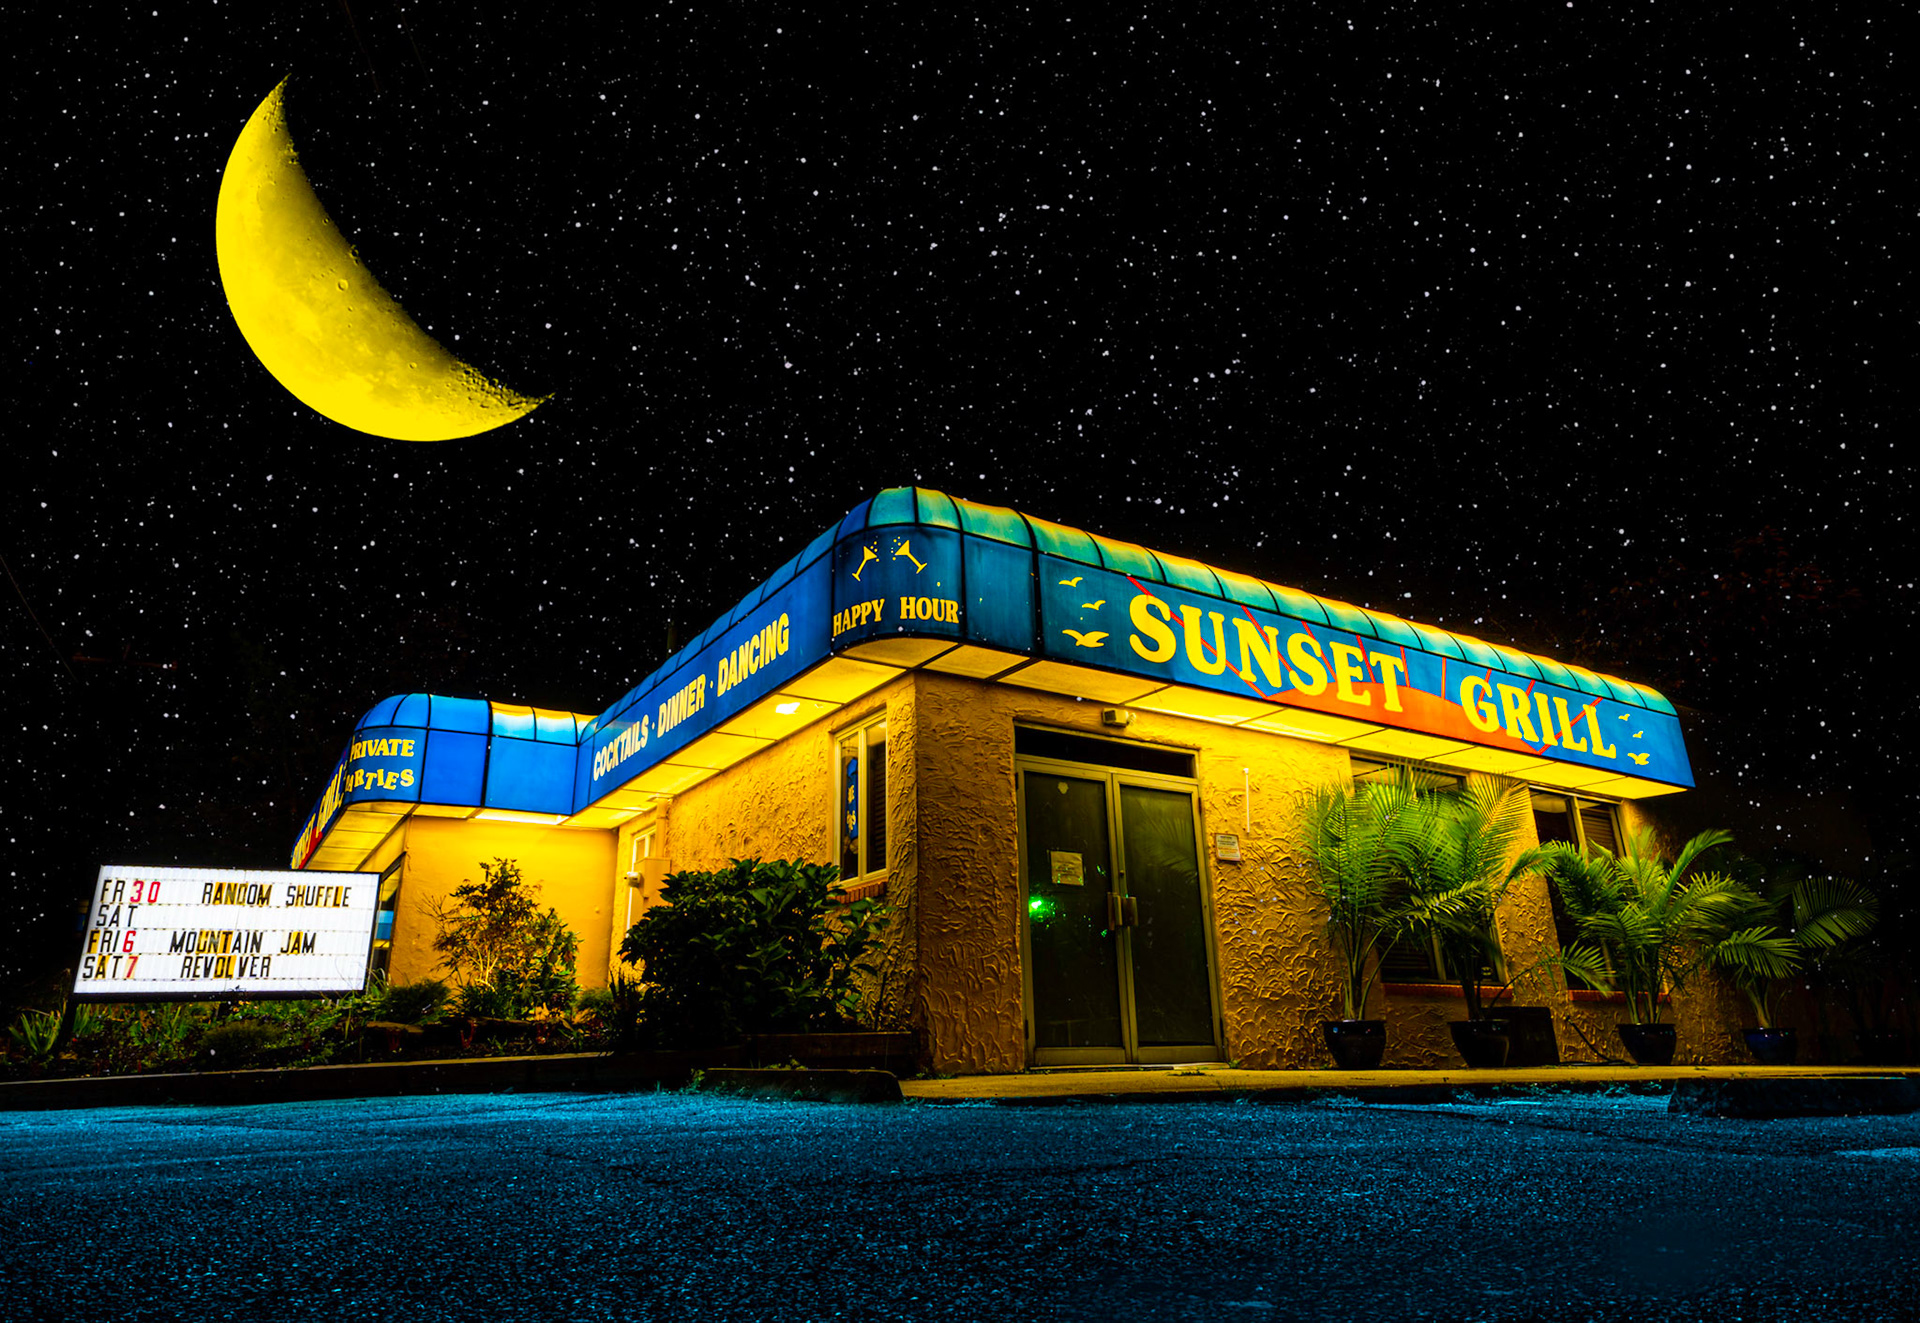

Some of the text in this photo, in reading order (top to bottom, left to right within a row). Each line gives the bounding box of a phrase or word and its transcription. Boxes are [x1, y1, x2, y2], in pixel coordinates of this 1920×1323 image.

[833, 596, 960, 637] HAPPY HOUR
[1129, 595, 1617, 760] SUNSET GRILL
[592, 612, 790, 782] COCKTAILS DINNER DANCING
[350, 738, 415, 762] PRIVATE
[202, 882, 272, 905] RANDOM
[285, 886, 352, 907] SHUFFLE
[96, 904, 138, 927] SAT
[169, 931, 263, 954] MOUNTAIN
[280, 932, 317, 954] JAM
[180, 956, 271, 979] REVOLVER
